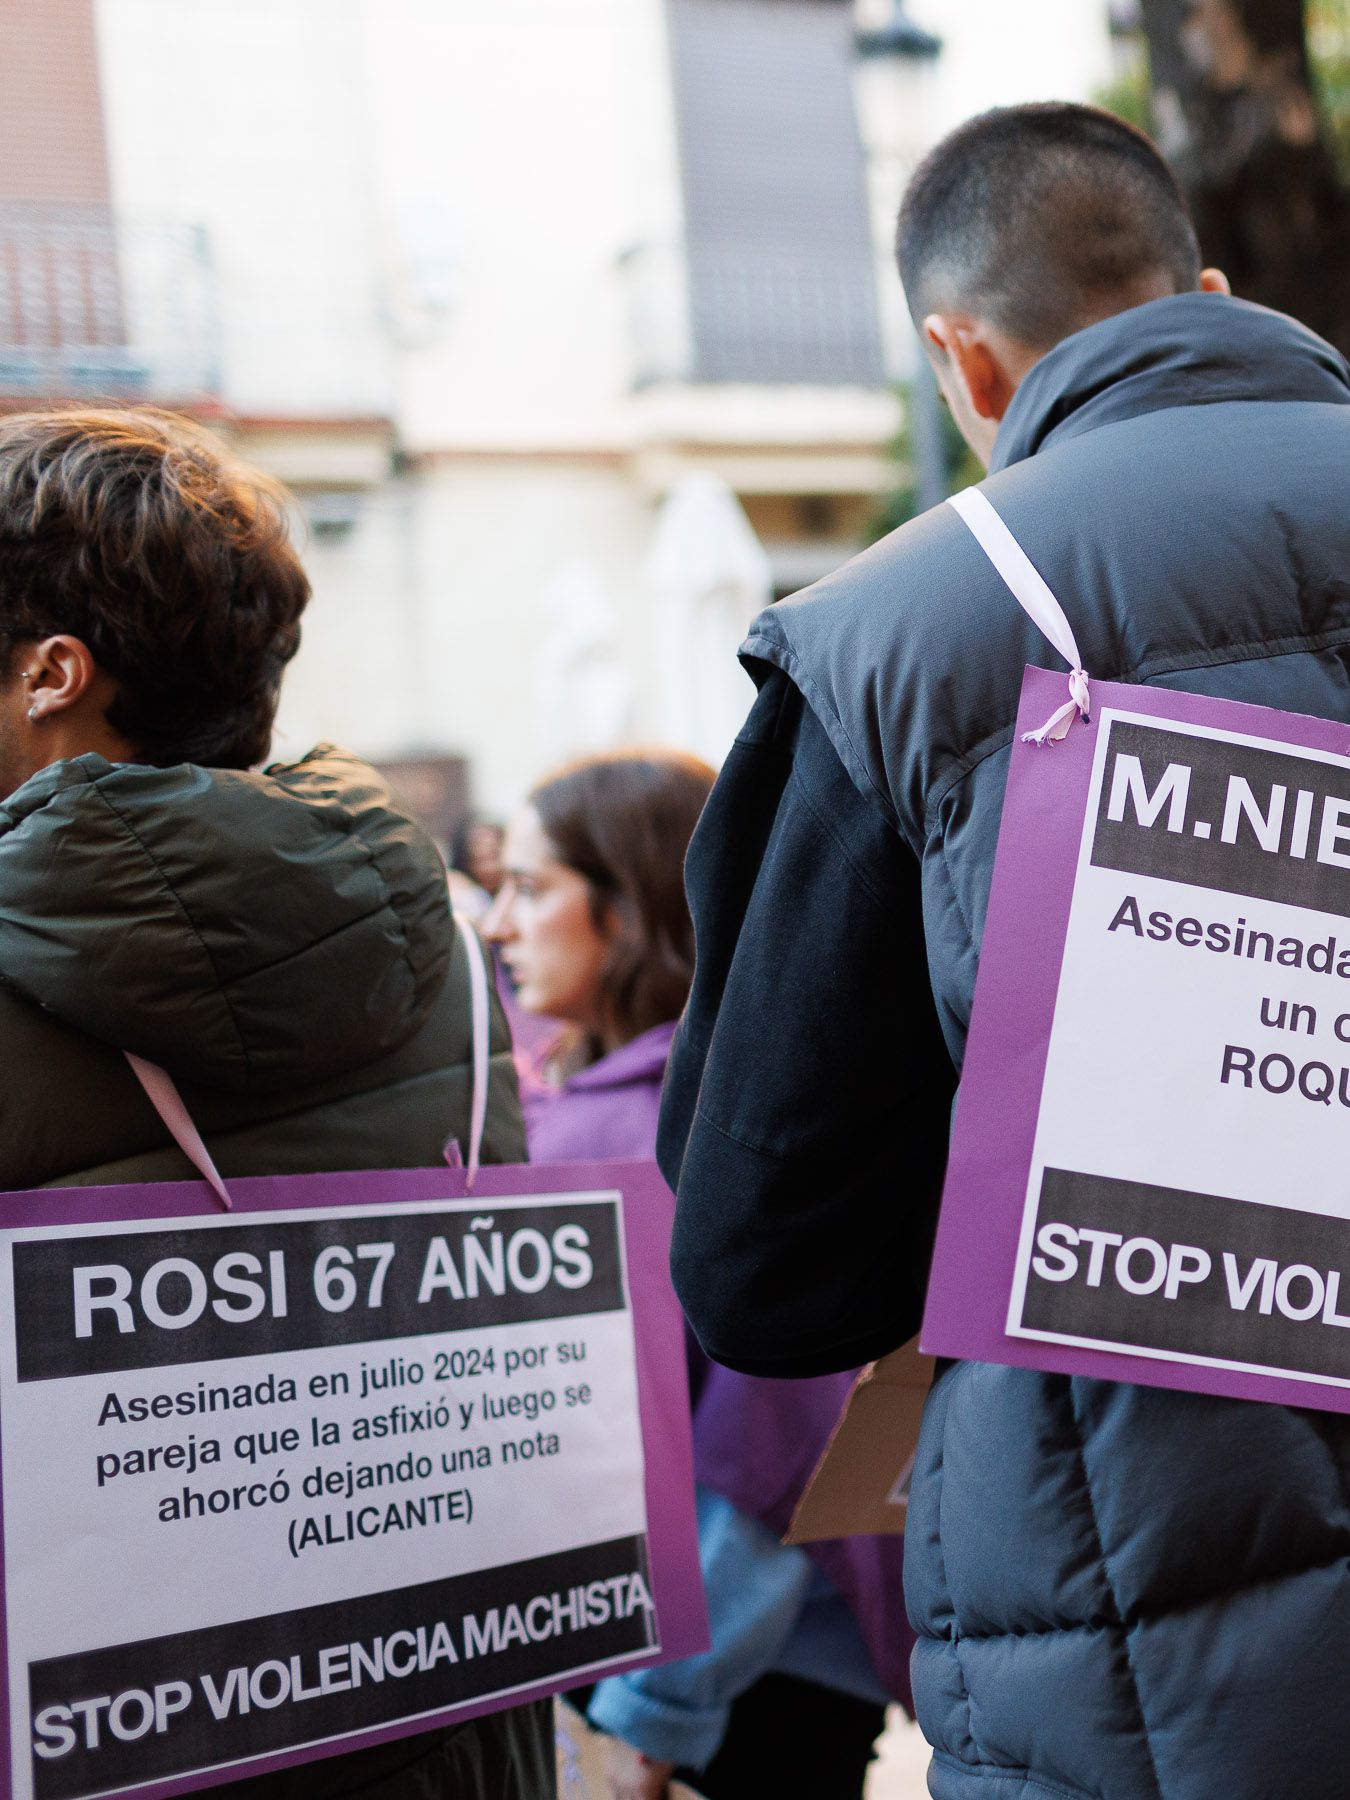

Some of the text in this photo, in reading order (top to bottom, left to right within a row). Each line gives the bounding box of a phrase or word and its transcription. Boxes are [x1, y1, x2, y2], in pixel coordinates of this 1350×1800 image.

[1261, 997, 1316, 1035] un
[73, 1217, 592, 1337] ROSI 67 AÑOS
[1033, 1223, 1211, 1299] STOP
[98, 1342, 586, 1426] Asesinada en julio 2024 por su
[97, 1384, 591, 1487] pareja que la asfixió y luego se
[159, 1432, 559, 1522] ahorcó dejando una nota
[289, 1489, 472, 1558] (ALICANTE)
[34, 1572, 654, 1758] STOP VIOLENCIA MACHISTA
